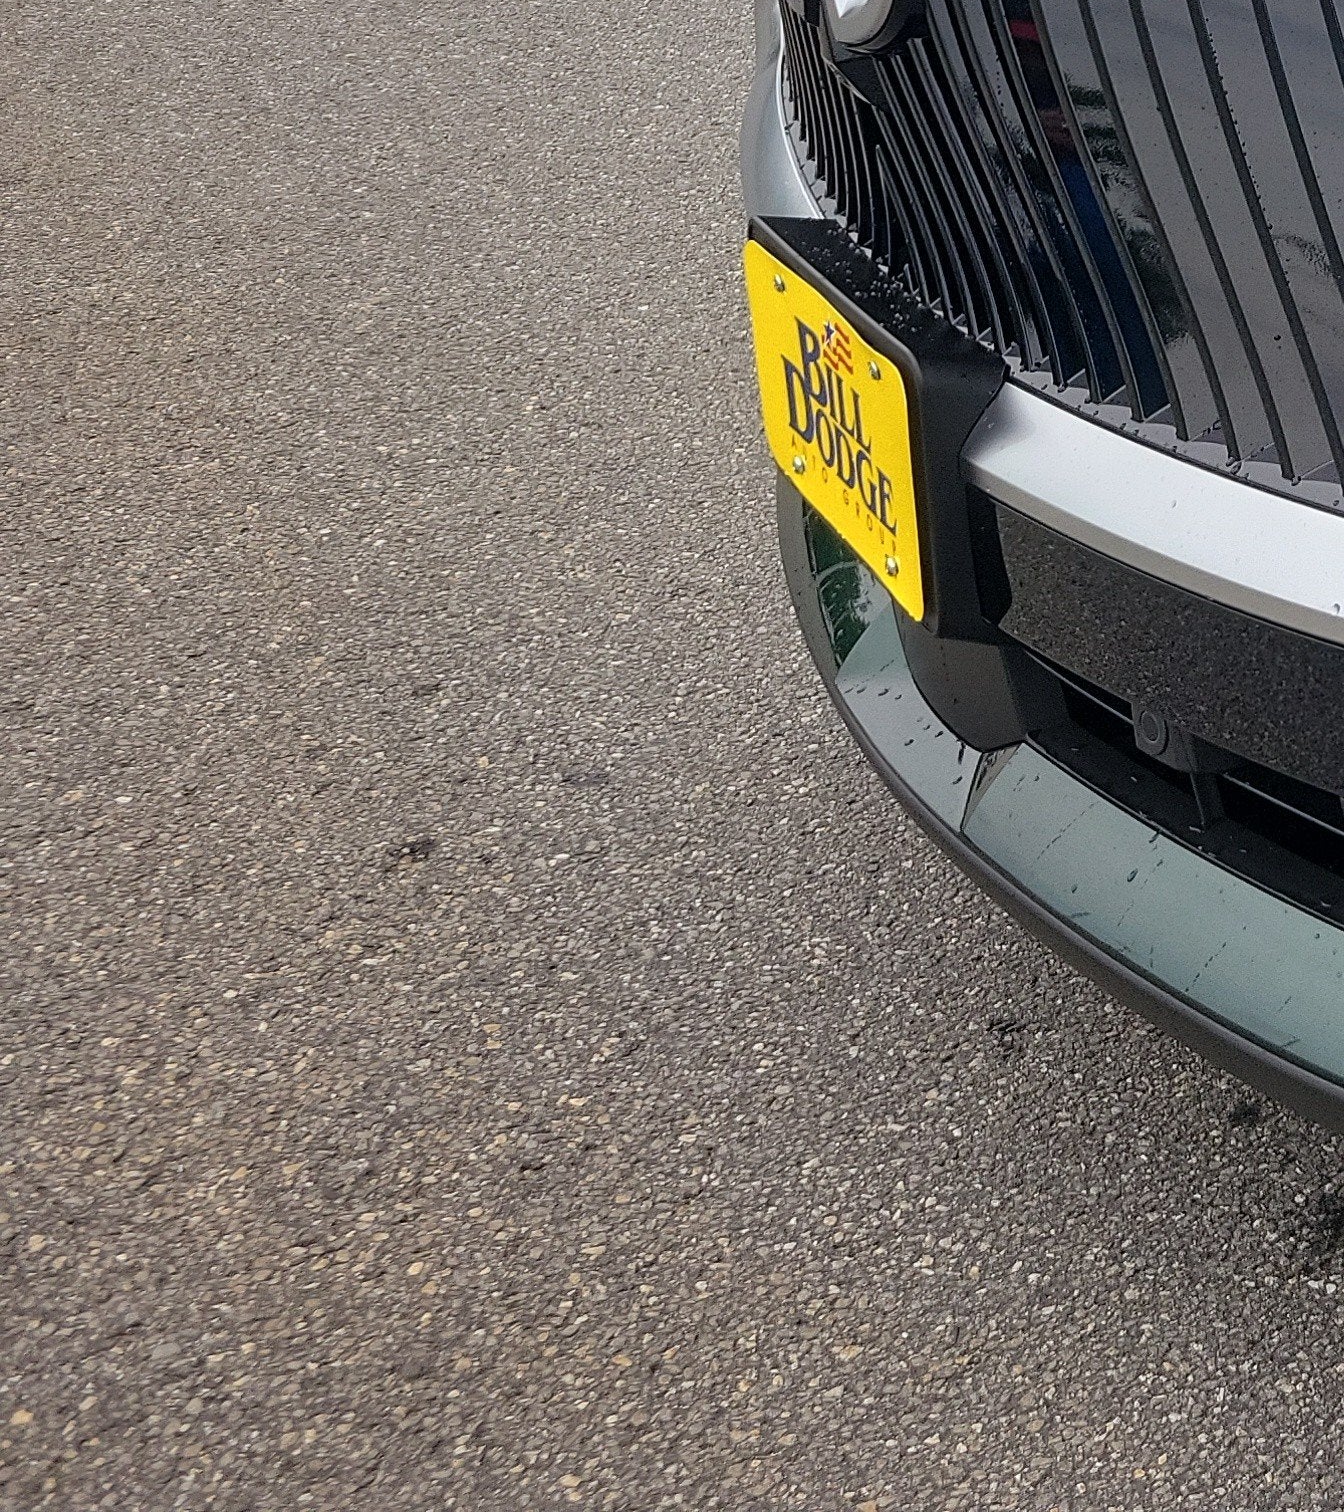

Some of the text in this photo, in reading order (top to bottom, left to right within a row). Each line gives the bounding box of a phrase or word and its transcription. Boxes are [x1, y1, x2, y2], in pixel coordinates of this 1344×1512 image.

[781, 354, 897, 537] DODGE
[794, 315, 872, 455] BILL
[843, 488, 897, 557] GROUP
